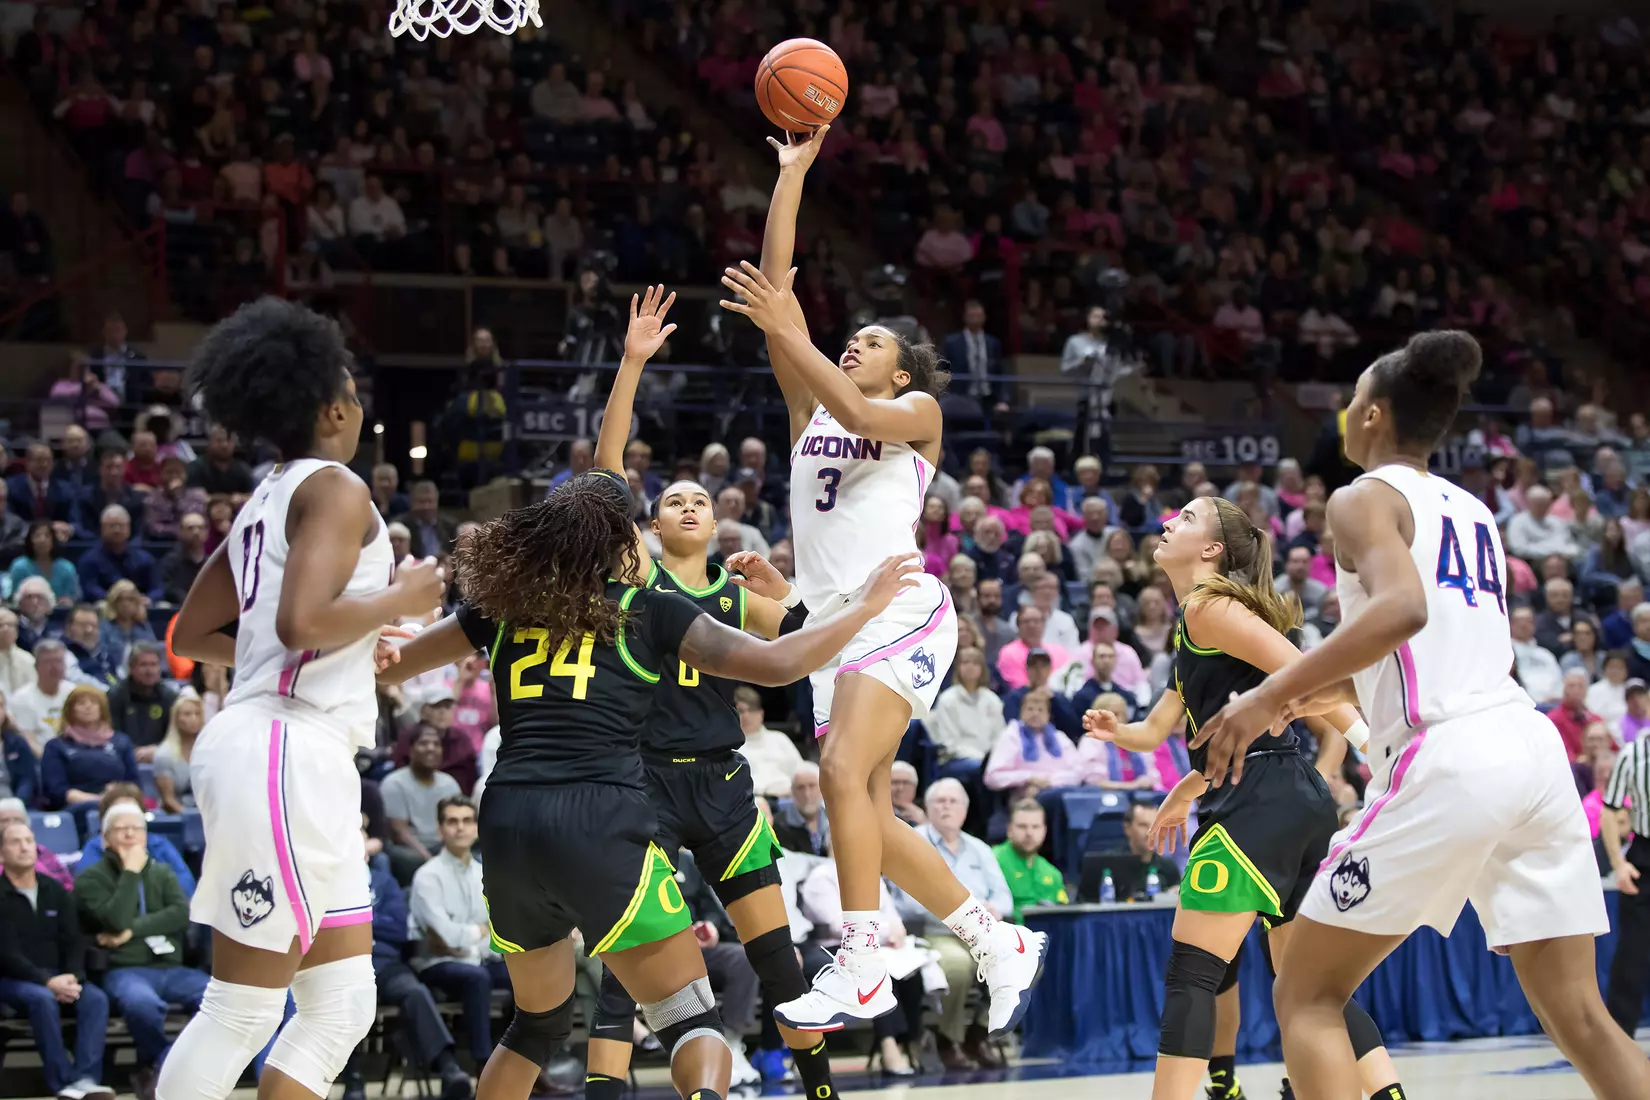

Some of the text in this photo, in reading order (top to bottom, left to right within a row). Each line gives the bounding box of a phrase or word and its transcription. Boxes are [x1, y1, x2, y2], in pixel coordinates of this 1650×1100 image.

[803, 85, 839, 114] ELITE
[524, 411, 566, 431] SEC
[801, 435, 882, 461] UCONN
[1221, 436, 1280, 465] 109
[815, 467, 842, 512] 3
[1436, 514, 1506, 616] 44
[510, 626, 597, 700] 24
[1190, 860, 1229, 894] O
